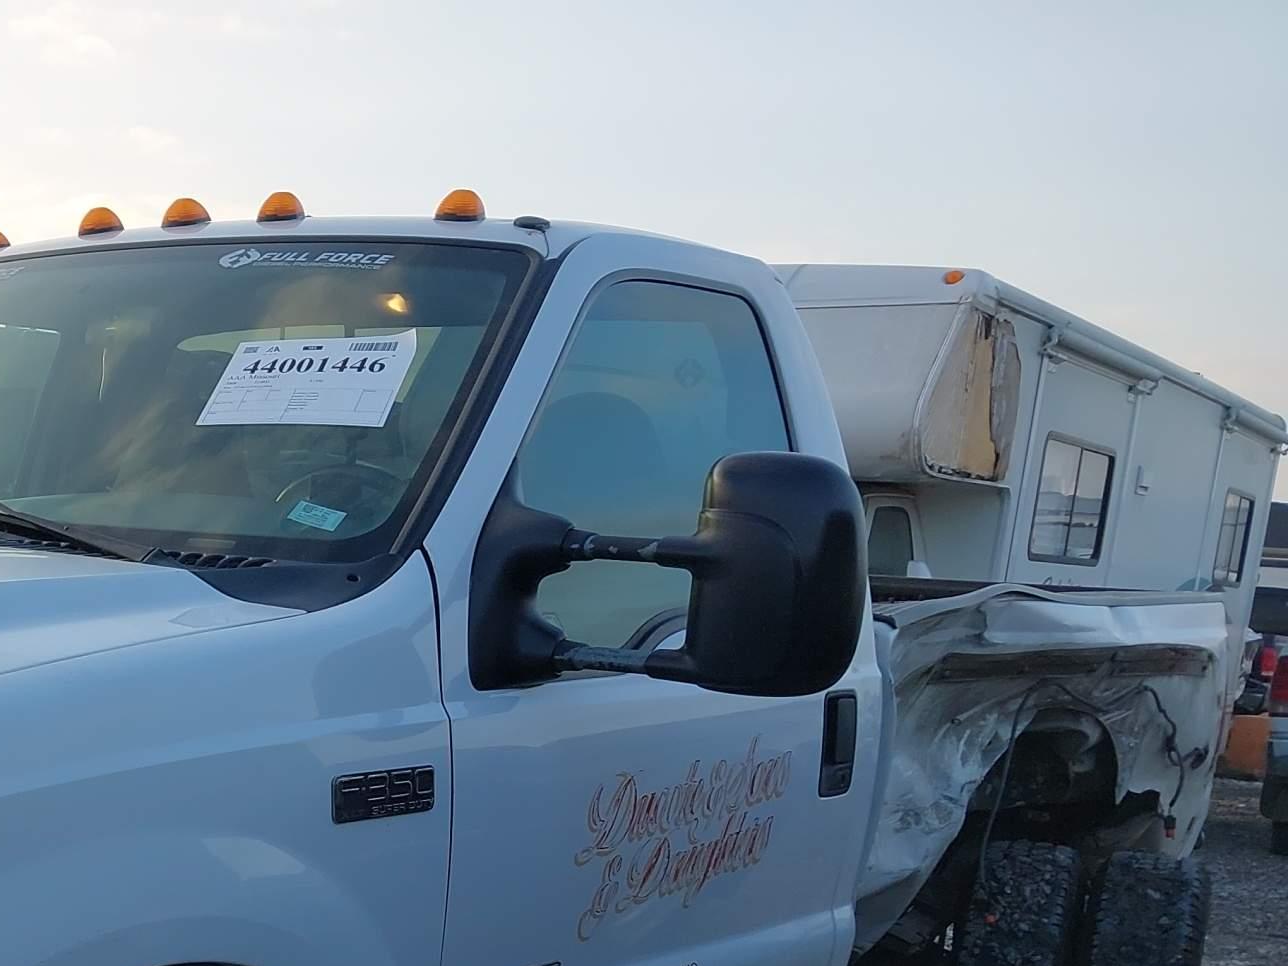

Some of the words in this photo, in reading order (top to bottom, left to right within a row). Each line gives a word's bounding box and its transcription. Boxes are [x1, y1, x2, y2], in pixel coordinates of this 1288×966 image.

[258, 251, 310, 262] FULL
[314, 252, 395, 265] FORCE
[242, 356, 387, 374] 44001446
